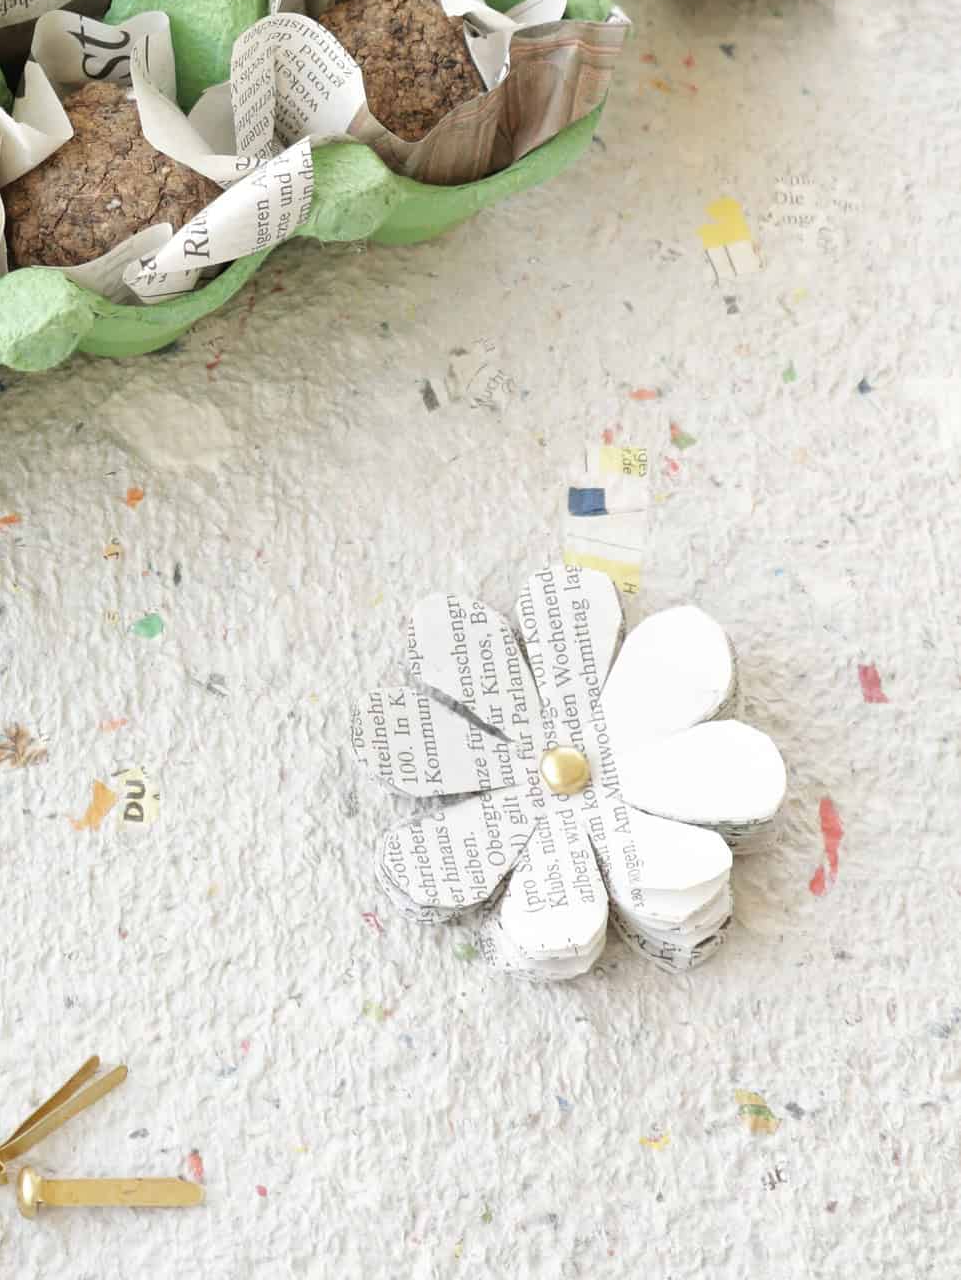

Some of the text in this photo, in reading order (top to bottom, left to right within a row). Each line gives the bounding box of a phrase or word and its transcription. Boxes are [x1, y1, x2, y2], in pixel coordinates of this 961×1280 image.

[478, 633, 499, 696] Kinos,
[393, 716, 410, 736] In
[514, 731, 535, 760] für
[400, 745, 418, 784] 100.
[524, 767, 546, 808] aber
[555, 809, 579, 844] wird
[434, 825, 461, 882] hinaus
